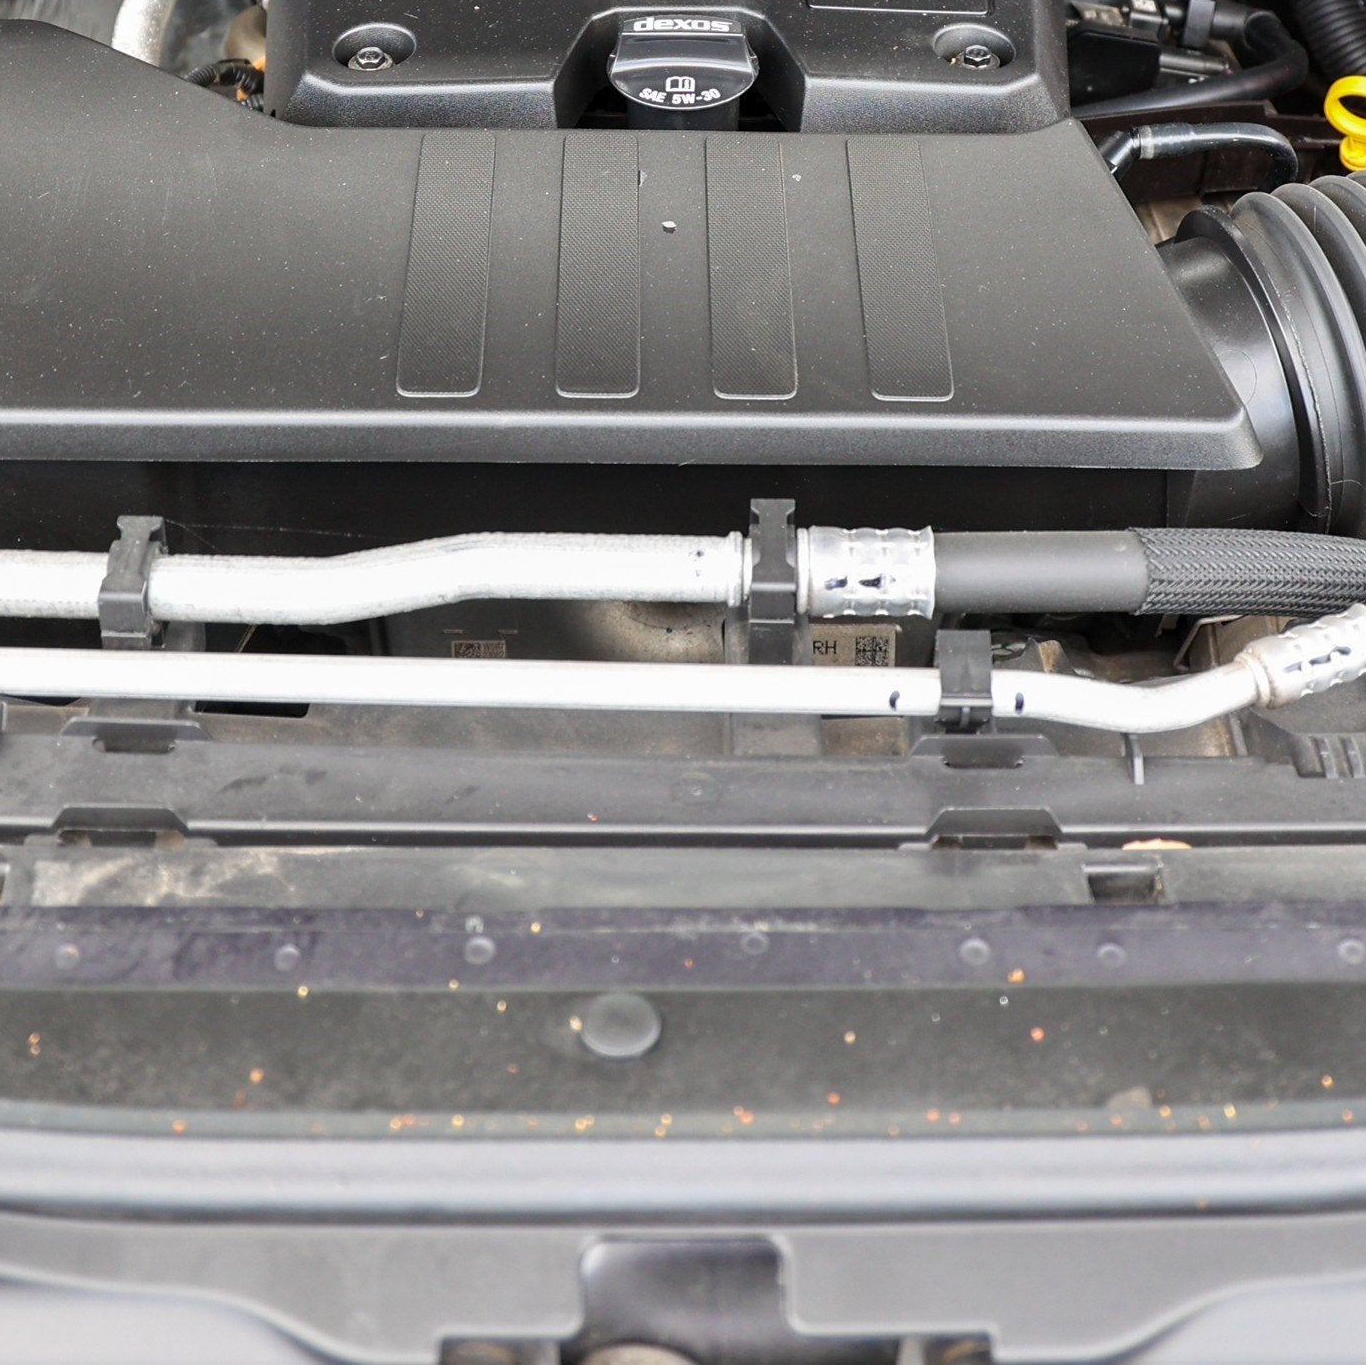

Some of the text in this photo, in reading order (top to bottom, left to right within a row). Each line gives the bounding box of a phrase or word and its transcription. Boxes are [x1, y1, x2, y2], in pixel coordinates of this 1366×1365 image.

[633, 17, 733, 33] dexos
[638, 87, 722, 105] SAE 5W-30
